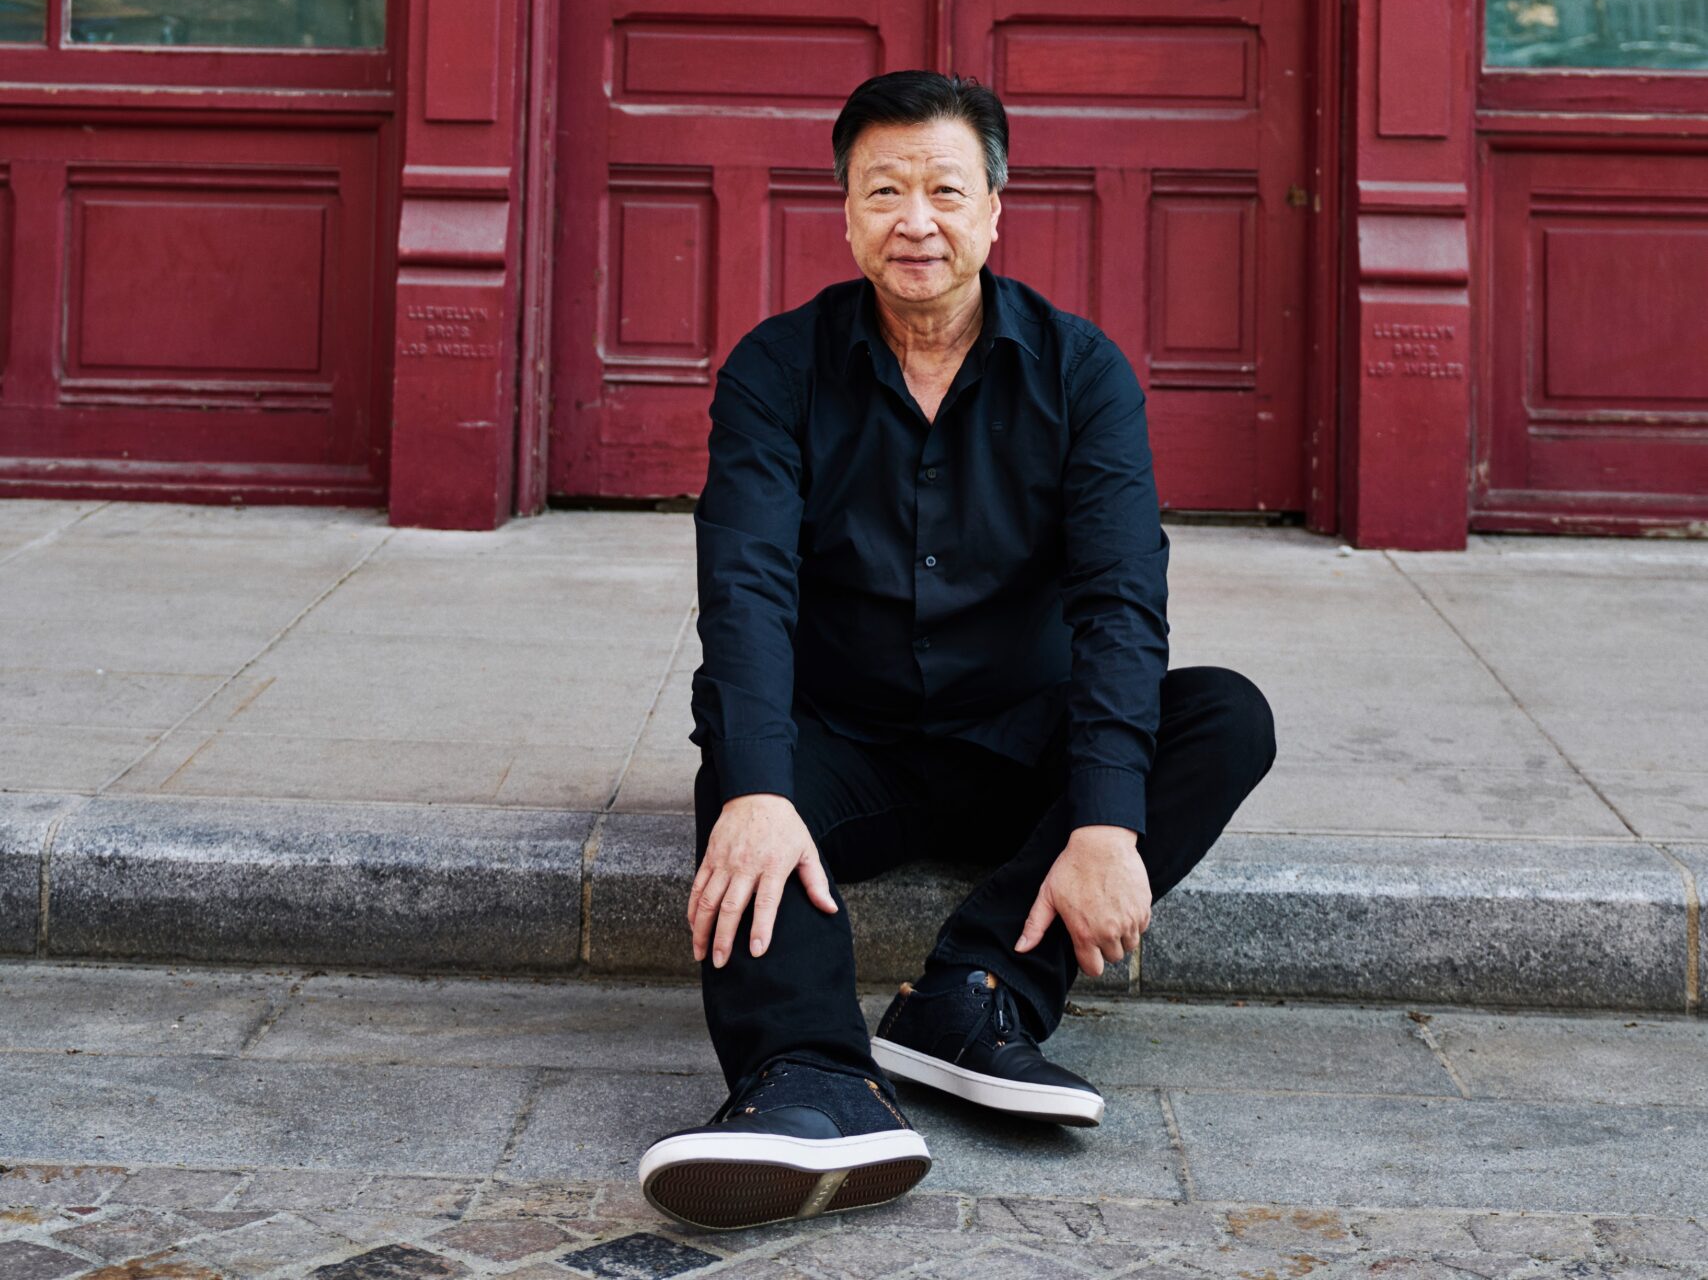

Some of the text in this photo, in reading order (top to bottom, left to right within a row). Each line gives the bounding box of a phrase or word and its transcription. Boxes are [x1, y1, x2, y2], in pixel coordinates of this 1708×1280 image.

[407, 304, 487, 320] LLEWELLYN
[1373, 323, 1455, 338] LLEWELLYN
[401, 341, 496, 358] LOS ANGELES
[1367, 361, 1464, 378] LOS ANGELES
